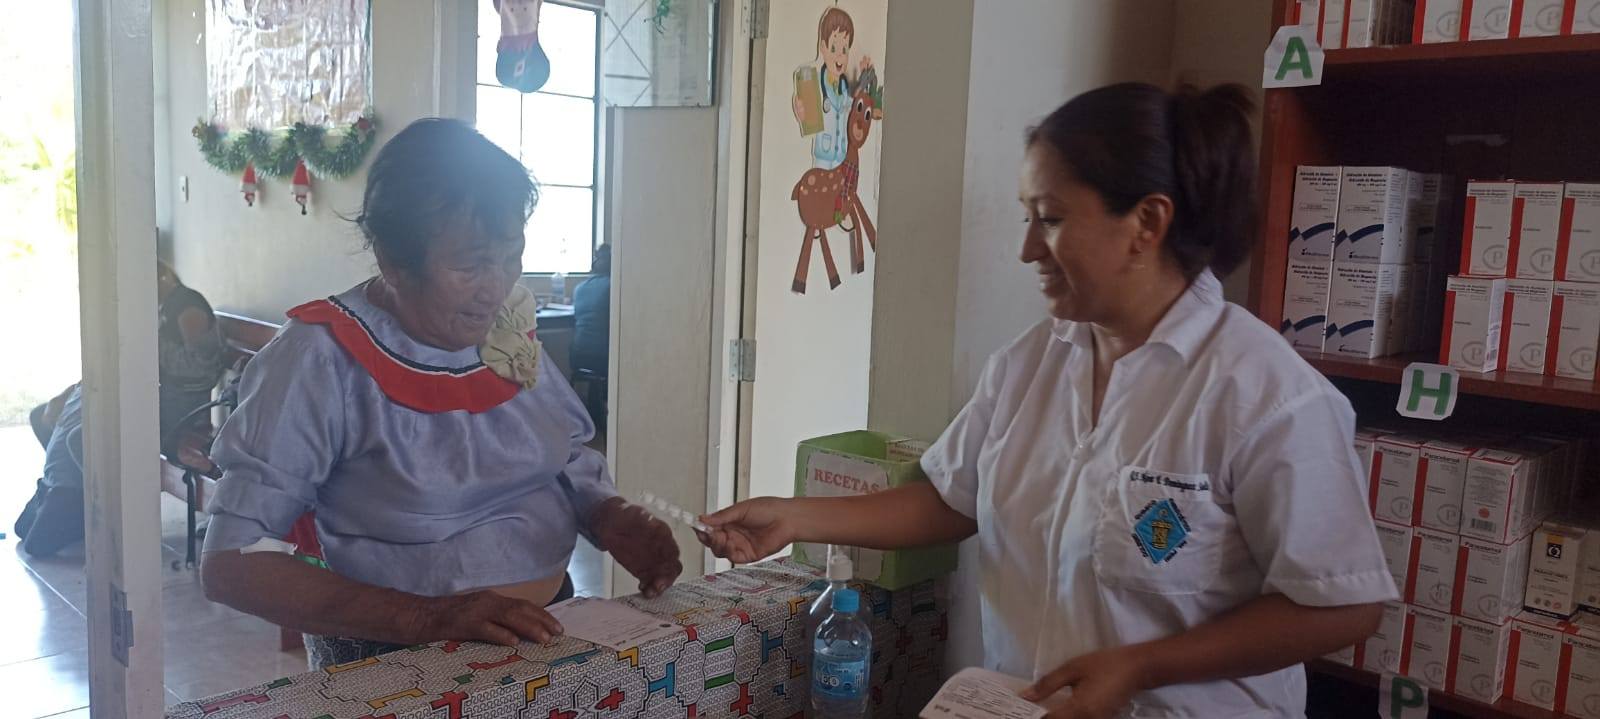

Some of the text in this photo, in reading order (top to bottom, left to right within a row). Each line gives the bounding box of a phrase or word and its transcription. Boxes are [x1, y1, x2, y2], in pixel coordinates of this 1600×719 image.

[1275, 37, 1313, 80] A
[1407, 369, 1451, 416] H
[815, 468, 880, 495] RECETAS
[1391, 677, 1424, 719] P
